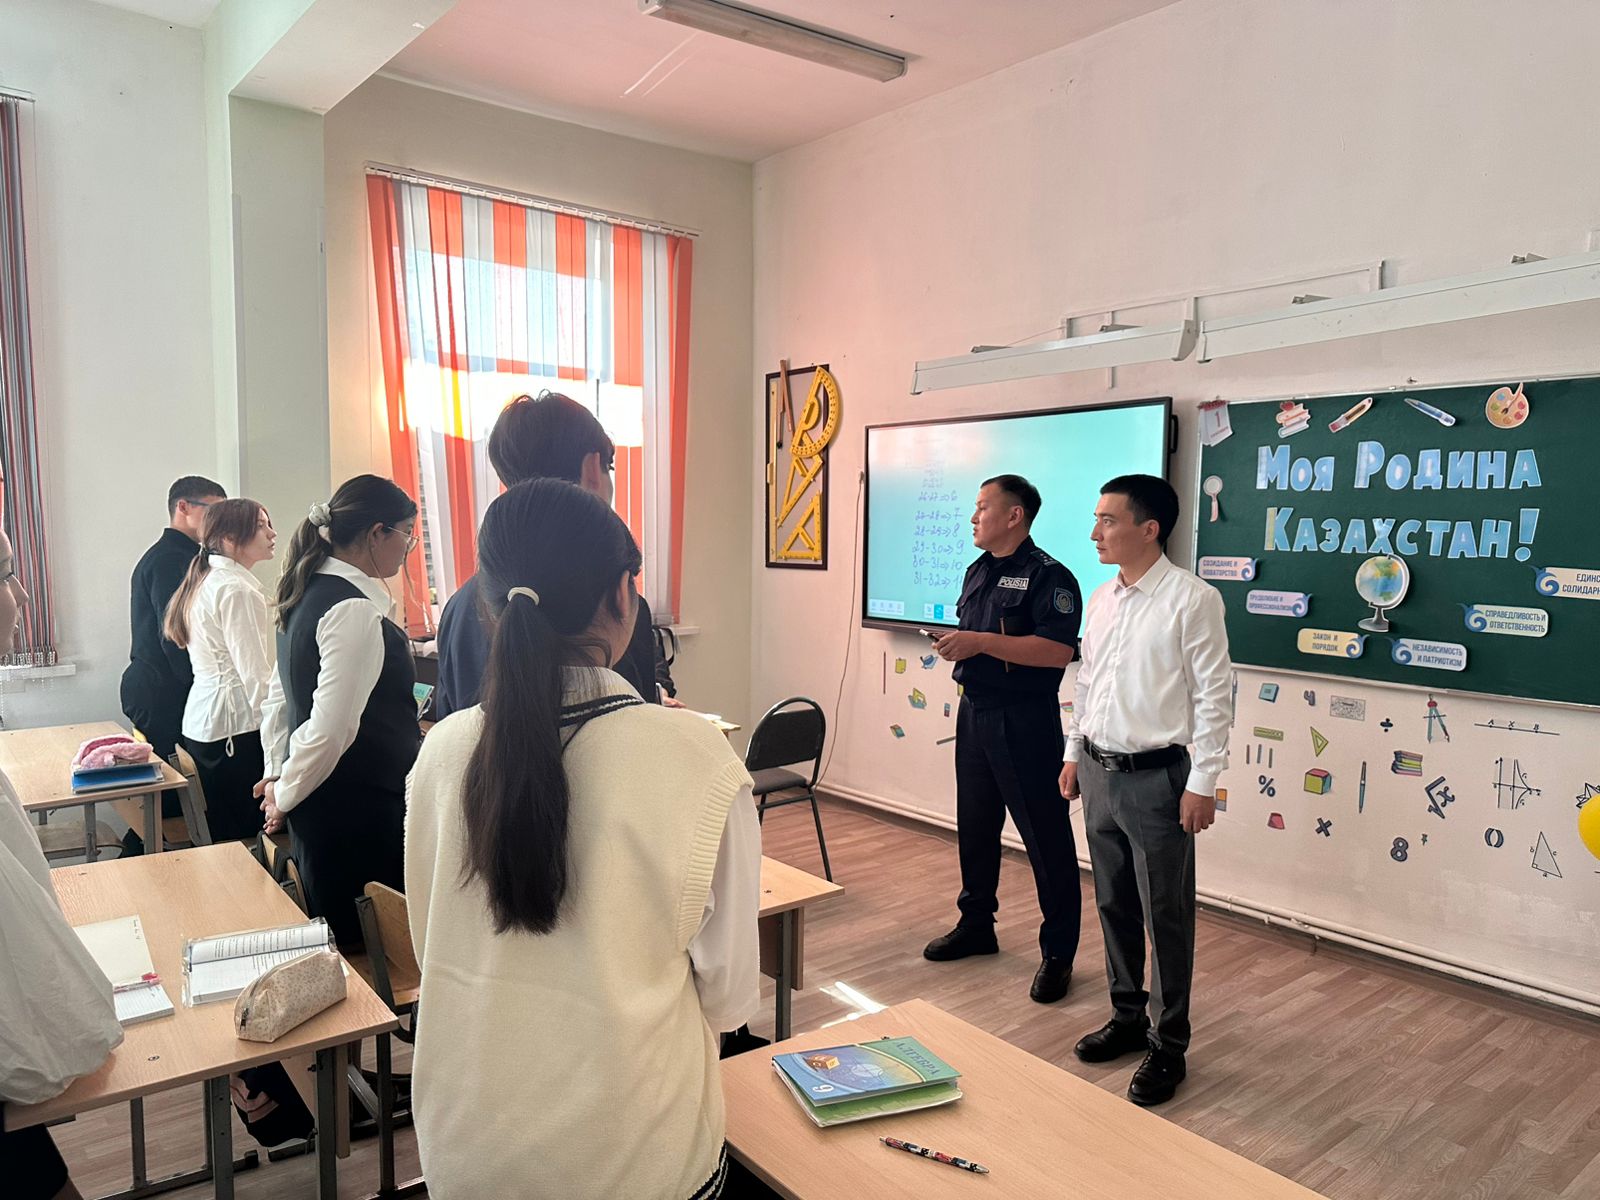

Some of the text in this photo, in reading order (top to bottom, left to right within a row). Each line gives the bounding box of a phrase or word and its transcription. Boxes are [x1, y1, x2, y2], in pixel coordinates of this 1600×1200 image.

[1485, 609, 1541, 621] СПРАВЕДЛИВОСТЬ
[1489, 621, 1545, 633] ОТВЕТСТВЕННОСТЬ
[1312, 632, 1331, 641] ЗАКОН
[1312, 642, 1338, 651] ПОРЯДОК
[1412, 643, 1463, 656] НЕЗАВИСИМОСТЬ
[1422, 656, 1462, 667] ПАТРИОТИЗМ
[1390, 837, 1409, 862] 8
